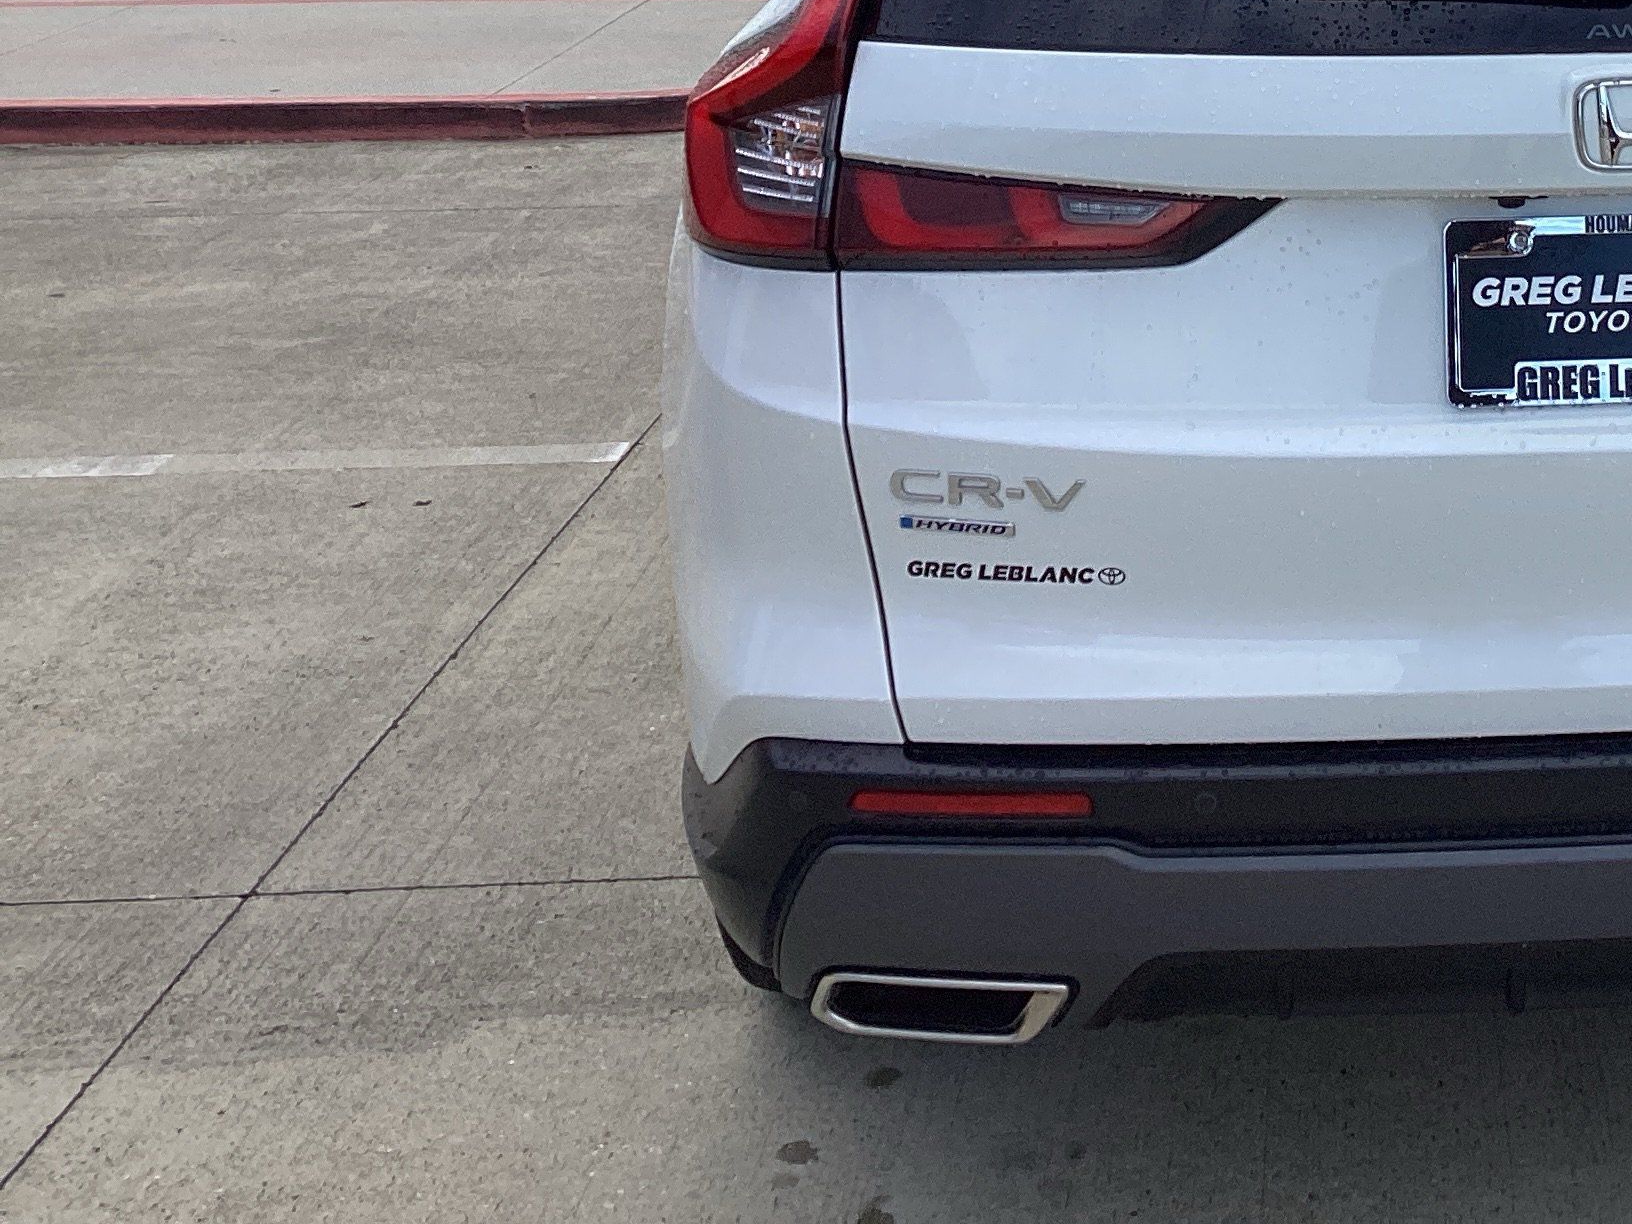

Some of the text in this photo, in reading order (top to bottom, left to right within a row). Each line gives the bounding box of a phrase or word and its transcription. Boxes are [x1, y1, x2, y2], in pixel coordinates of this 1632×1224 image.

[1472, 275, 1582, 308] GREG
[1517, 361, 1600, 401] GREG
[889, 469, 1087, 513] CR-V
[915, 519, 1007, 535] HYBRID
[907, 560, 1095, 584] GREG LEBLANC
